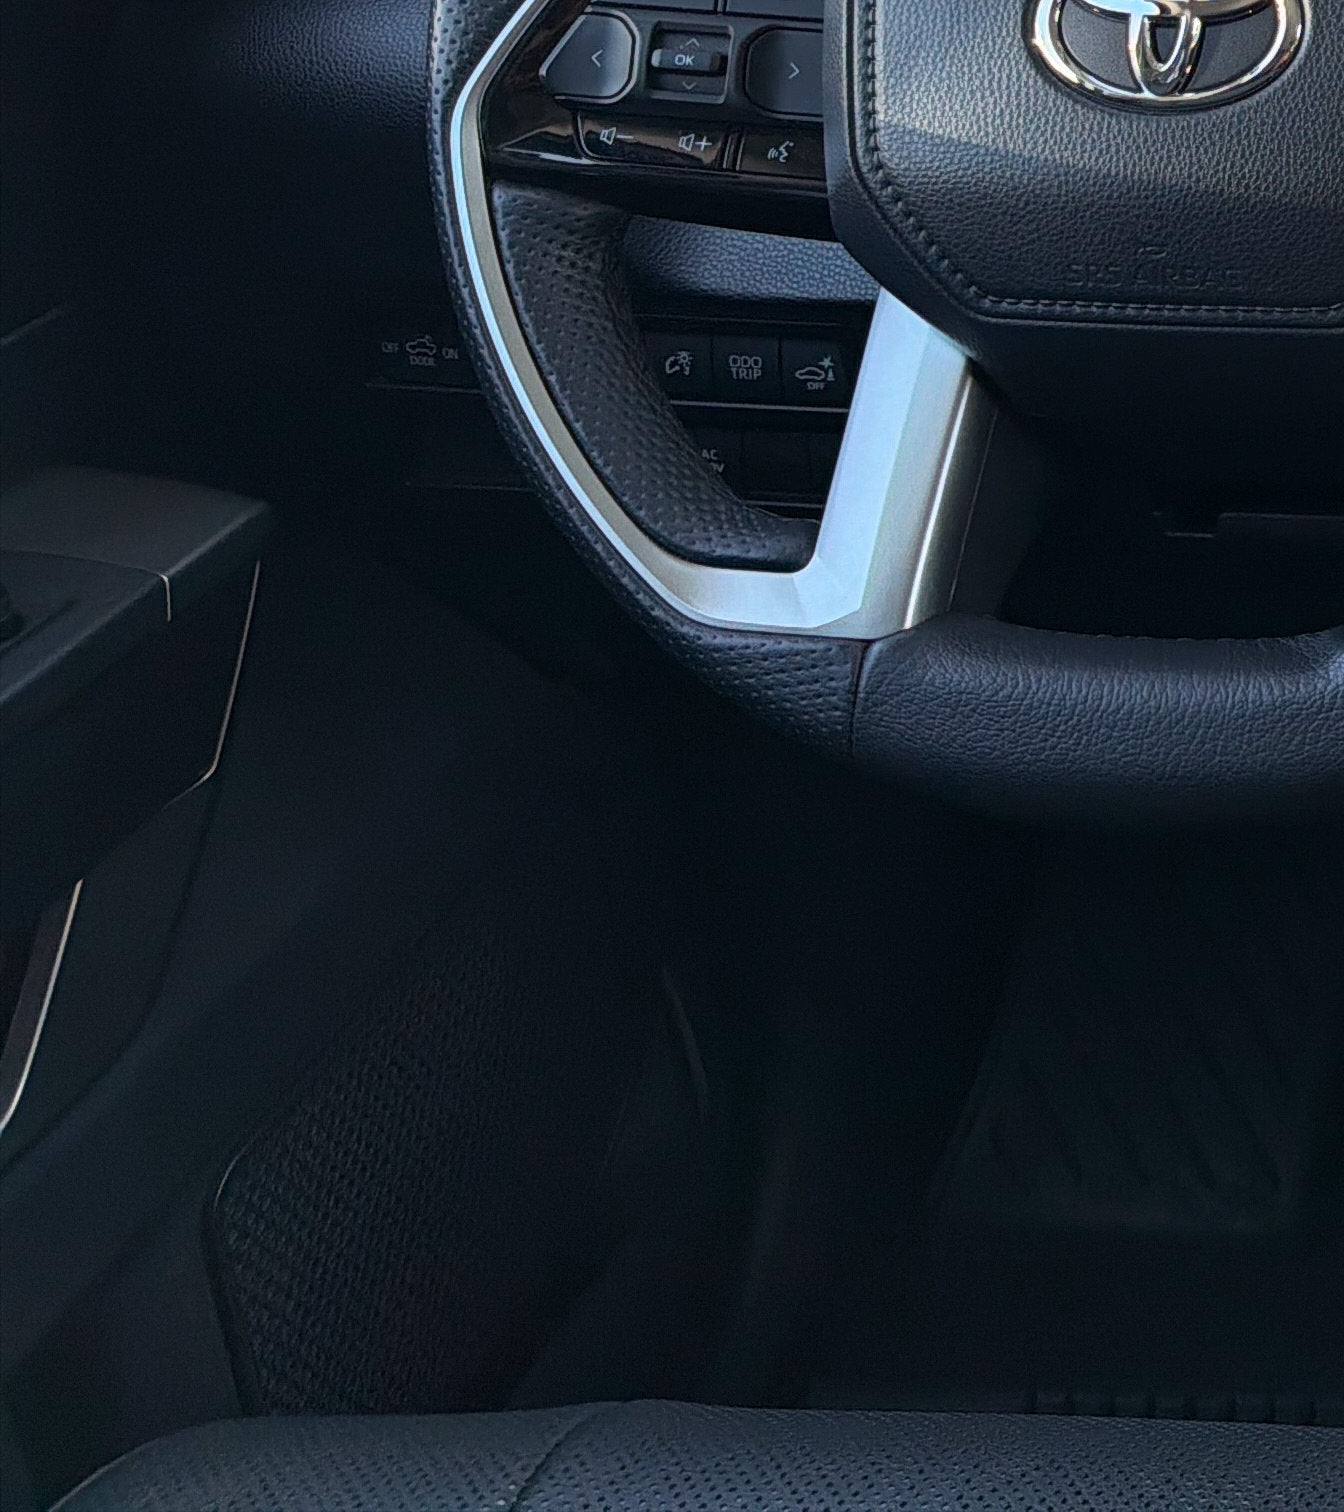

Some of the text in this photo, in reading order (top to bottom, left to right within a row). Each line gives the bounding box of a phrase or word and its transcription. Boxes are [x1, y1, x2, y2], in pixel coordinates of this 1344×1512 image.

[675, 54, 695, 66] OK
[729, 355, 762, 368] ODO
[731, 368, 761, 380] TRIP
